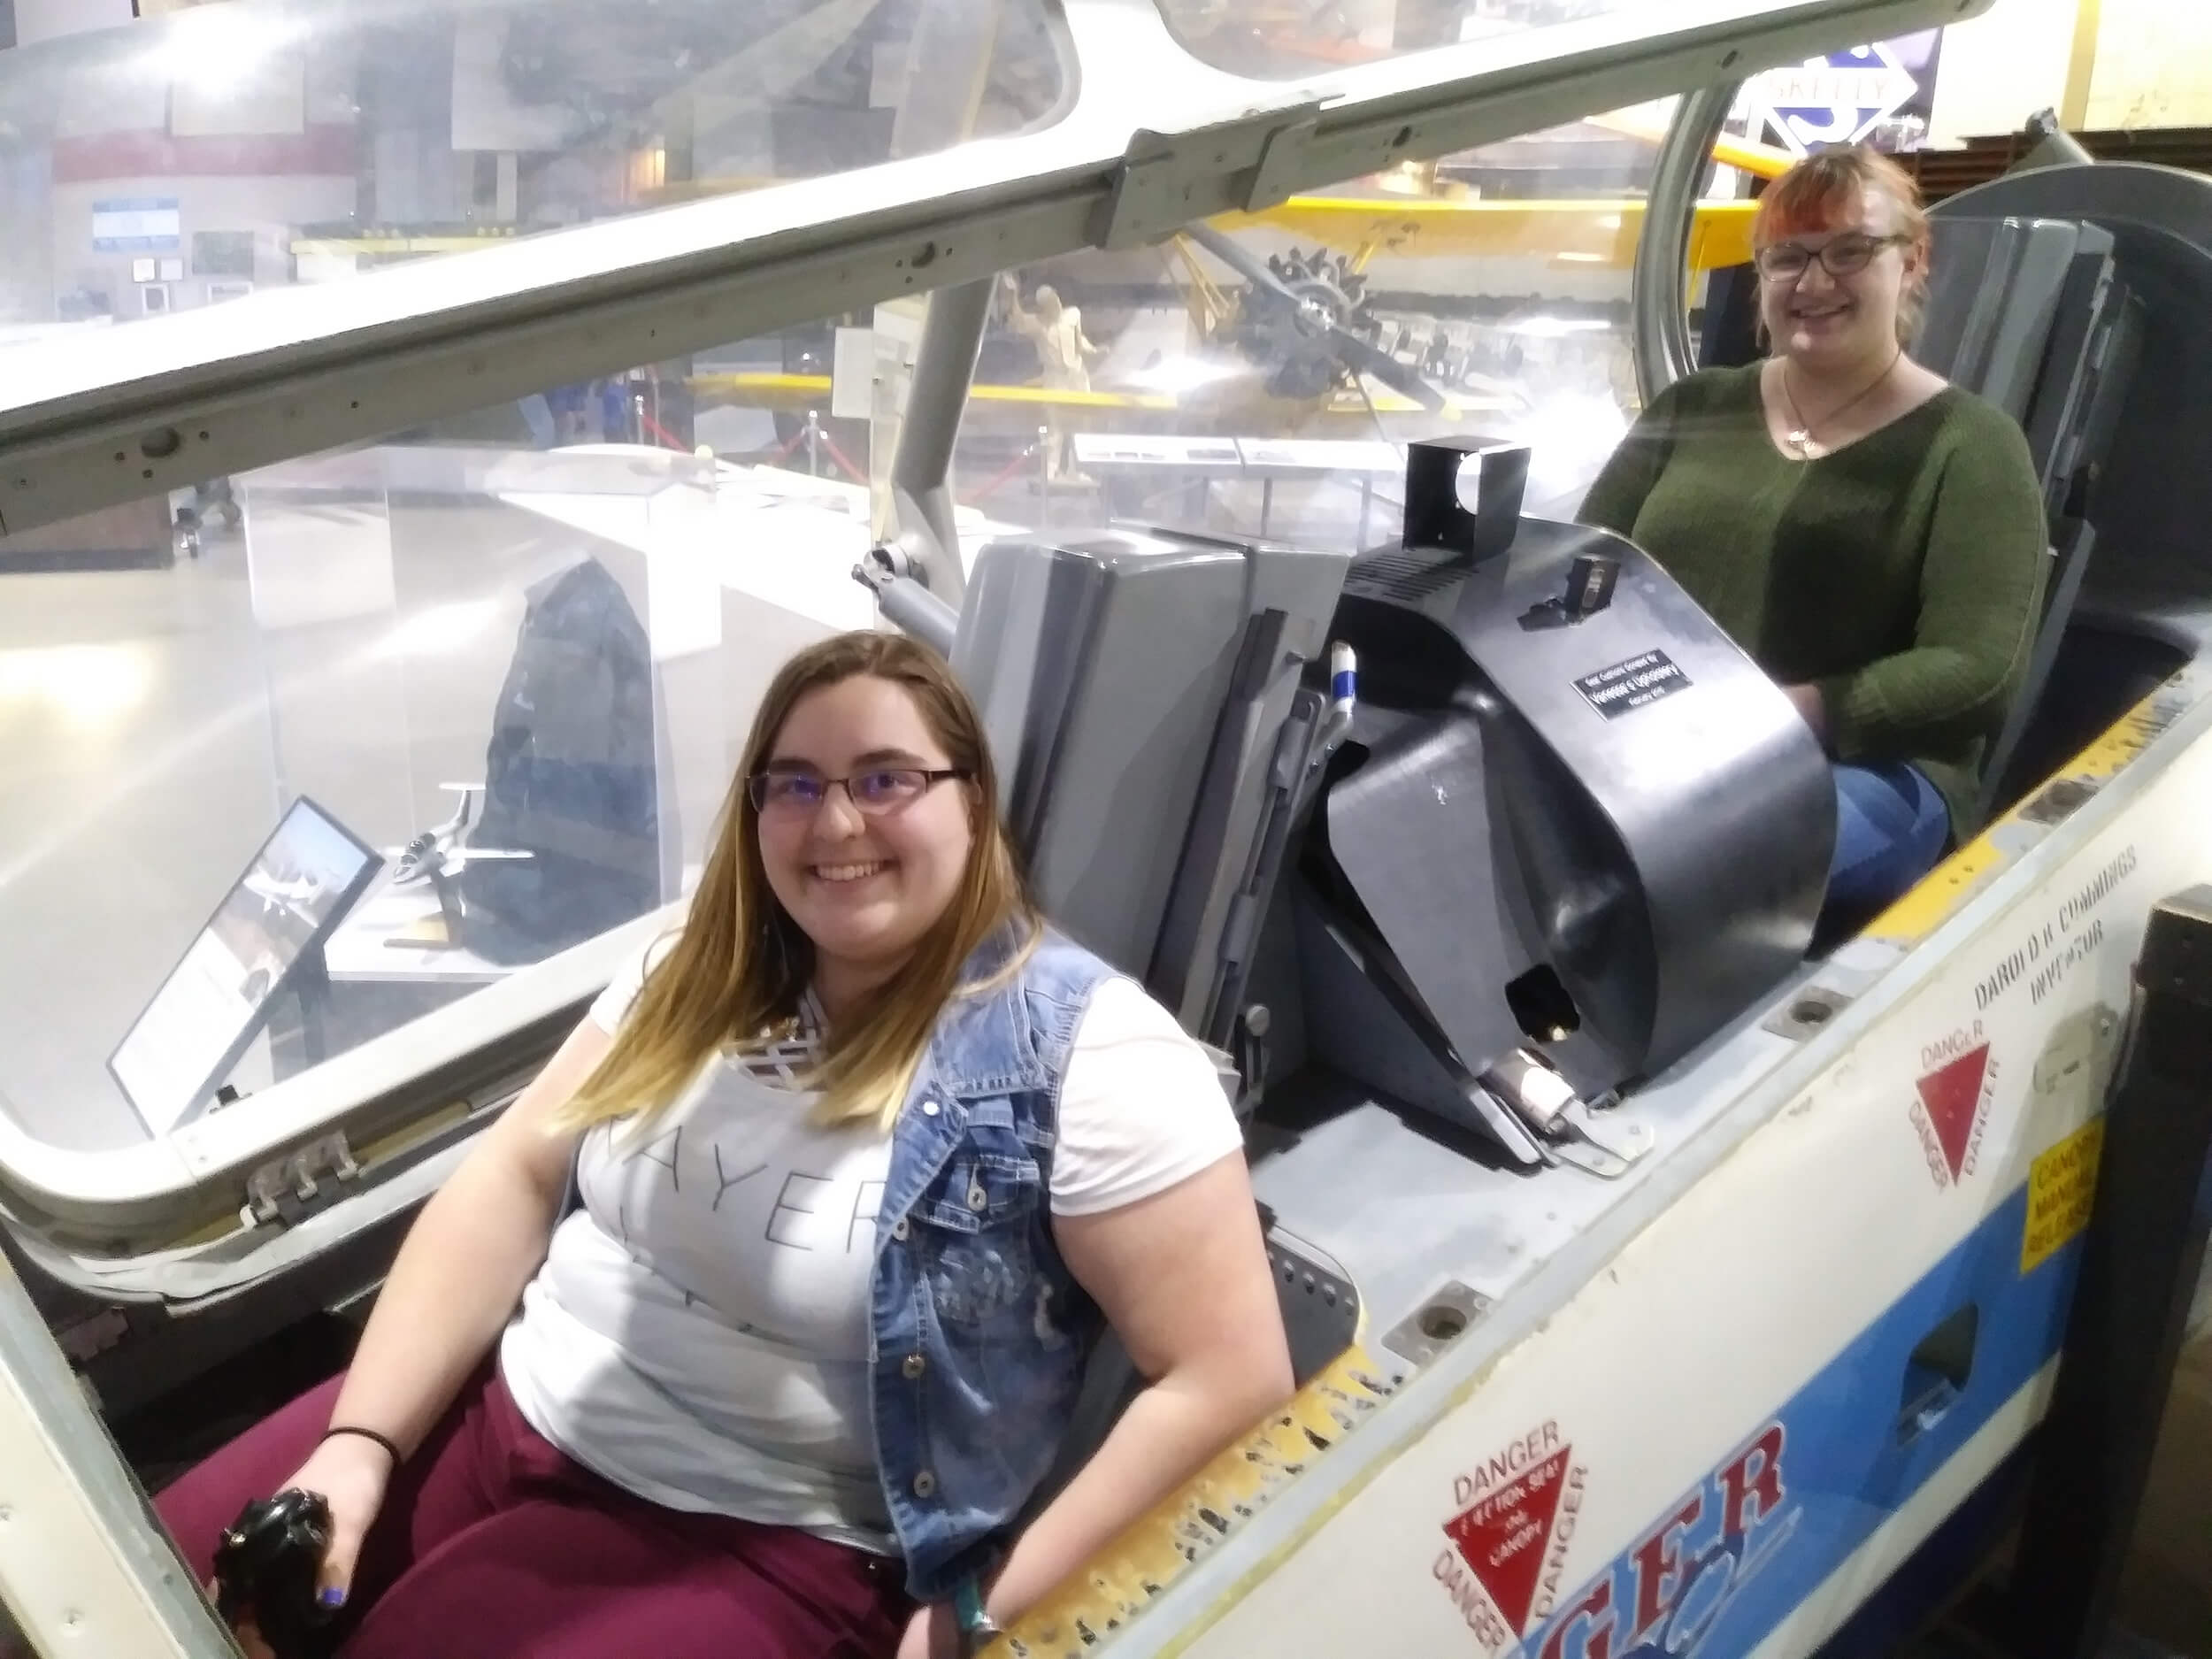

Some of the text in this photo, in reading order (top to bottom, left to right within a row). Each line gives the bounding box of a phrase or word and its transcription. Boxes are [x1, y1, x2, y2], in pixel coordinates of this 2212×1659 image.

[2058, 843, 2138, 933] CUMMINGS
[1921, 1018, 1983, 1070] DANGER
[1963, 1057, 2000, 1177] DANGER
[1454, 1419, 1559, 1507] DANGER
[1534, 1465, 1589, 1618] DANGER
[1432, 1549, 1507, 1650] DANGER
